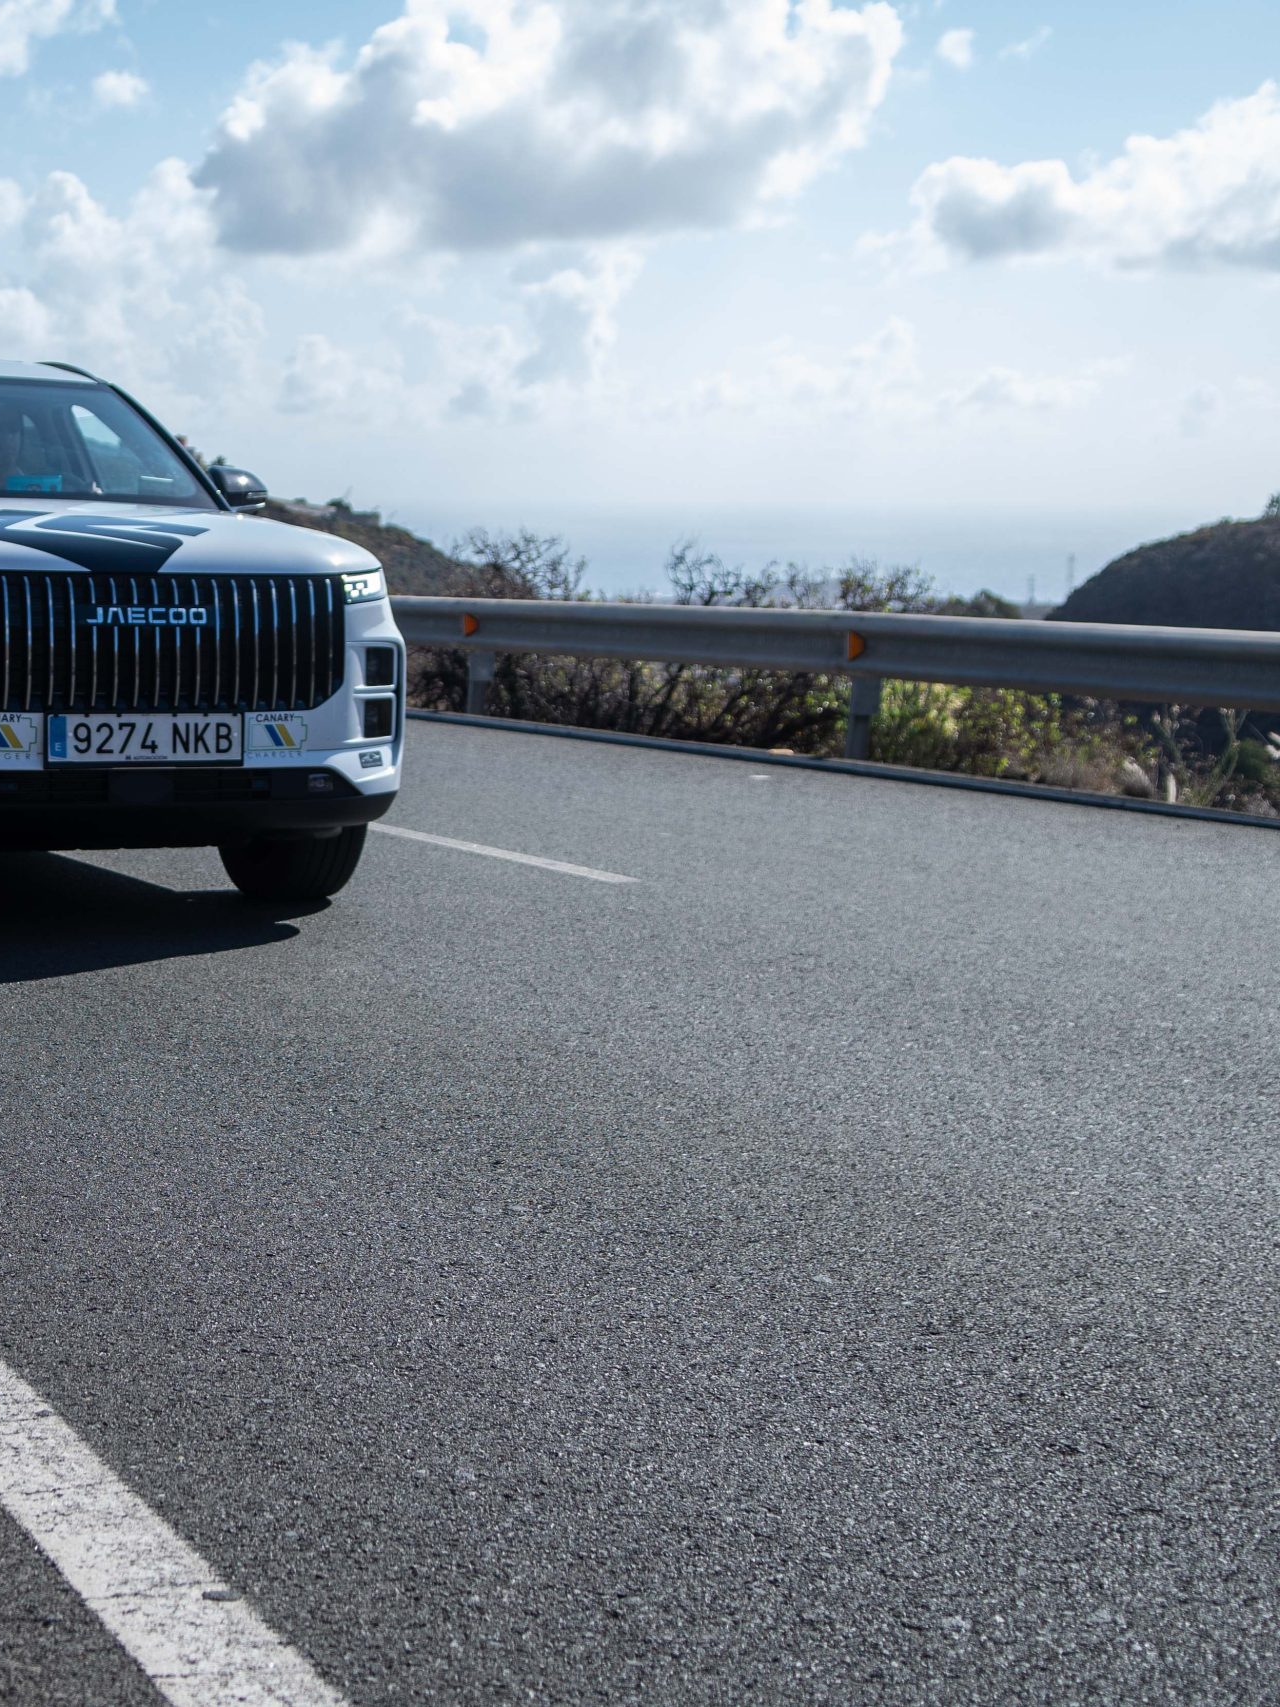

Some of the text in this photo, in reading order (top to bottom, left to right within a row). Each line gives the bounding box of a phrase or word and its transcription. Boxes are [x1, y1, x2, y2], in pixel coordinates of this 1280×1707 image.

[86, 606, 207, 625] JAECOO
[255, 713, 294, 723] CANARY
[73, 722, 233, 754] 9274 NKB
[55, 743, 62, 751] E
[246, 750, 303, 760] CHARGER
